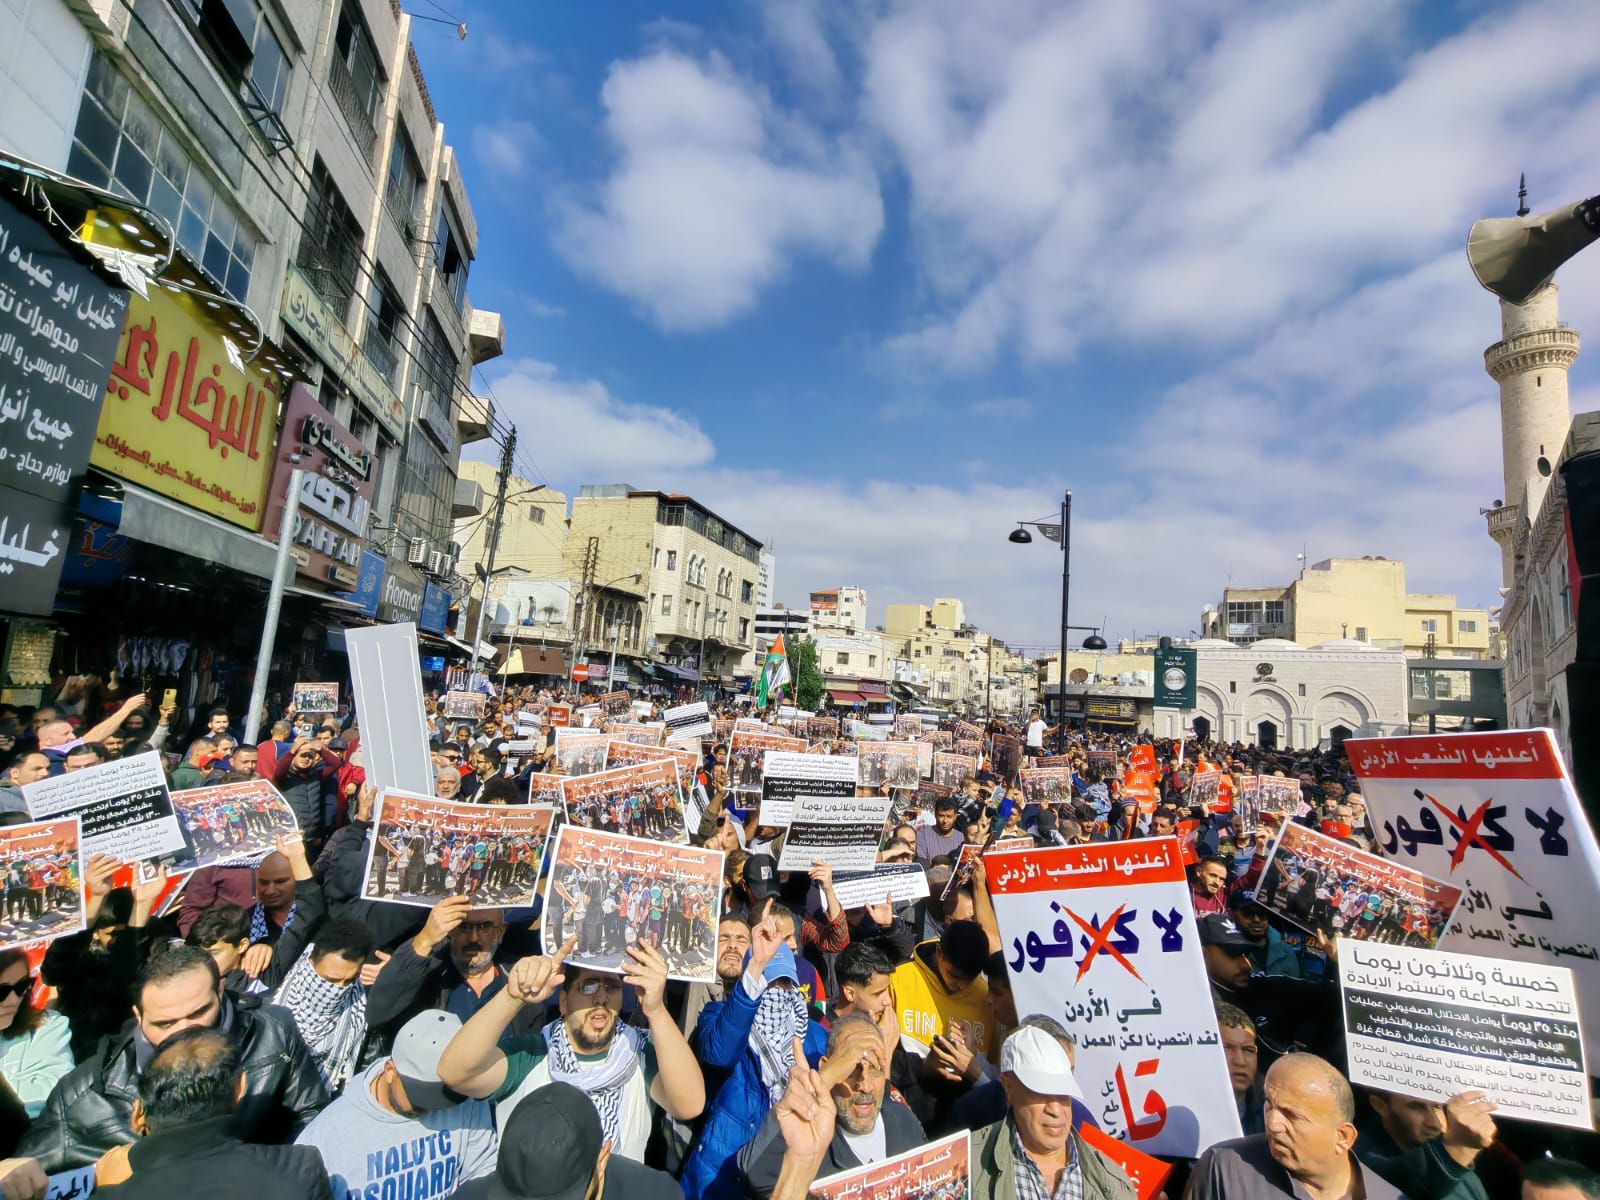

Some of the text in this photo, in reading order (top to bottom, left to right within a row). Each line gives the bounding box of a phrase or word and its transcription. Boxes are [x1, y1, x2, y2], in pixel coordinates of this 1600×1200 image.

[0, 384, 74, 451] جميع أنوا
[42, 462, 72, 488] لوازم
[1359, 738, 1539, 776] أعلنها الشعب الأردني
[400, 799, 419, 811] غزة
[398, 813, 534, 834] مسؤولية الأنظمة العربية
[497, 810, 537, 821] كسر
[1381, 789, 1569, 857] لا كارفور
[577, 834, 597, 847] غزة
[1299, 832, 1321, 848] غزة
[0, 844, 56, 860] مسؤول
[669, 855, 706, 865] كسر
[1295, 845, 1335, 866] العربية
[575, 850, 705, 881] مسؤولية الأنظمة العربية
[997, 846, 1170, 892] أعلنها الشعب الأردني
[1398, 874, 1443, 893] كسر
[1383, 881, 1436, 906] مسؤولية
[1500, 891, 1553, 930] في
[1008, 900, 1184, 973] لا كارفور
[1468, 924, 1505, 942] العمل
[1509, 933, 1536, 948] لكن
[1407, 958, 1487, 986] وثلاثون
[1491, 968, 1559, 993] خمسة
[1397, 980, 1456, 1001] وتستمر
[1459, 986, 1521, 1008] المجاعة
[1348, 994, 1385, 1009] عمليات
[1384, 1001, 1433, 1016] الصهيوني
[1525, 1000, 1571, 1016] تتجدد
[1065, 988, 1162, 1032] في الأردن
[1434, 1009, 1472, 1023] الاحتلال
[1356, 1022, 1374, 1034] غزة
[1368, 1013, 1413, 1029] والتخريب
[1471, 1015, 1502, 1031] يواصل
[1533, 1021, 1550, 1034] ٣٥
[1374, 1026, 1402, 1039] قطاع
[1414, 1022, 1454, 1037] والتدمير
[1455, 1027, 1497, 1043] والتجويع
[1553, 1022, 1578, 1039] منذ
[1081, 1030, 1218, 1050] لقد انتصرنا لكن العمل
[1403, 1032, 1431, 1045] شمال
[1432, 1036, 1469, 1051] منطقة
[1352, 1040, 1388, 1055] المجرم
[1470, 1043, 1504, 1057] لسكان
[1354, 1054, 1371, 1065] من
[1390, 1050, 1442, 1065] الصهيوني
[1444, 1057, 1483, 1072] الاحتلال
[1537, 1054, 1578, 1070] والتطهير
[1396, 1076, 1443, 1095] مقومات
[1558, 1073, 1583, 1088] منذ
[1500, 1084, 1553, 1099] المساعدات
[367, 1129, 452, 1181] NALUTC
[914, 1144, 953, 1171] كسر
[873, 1168, 954, 1200] مسؤولية الأنظ
